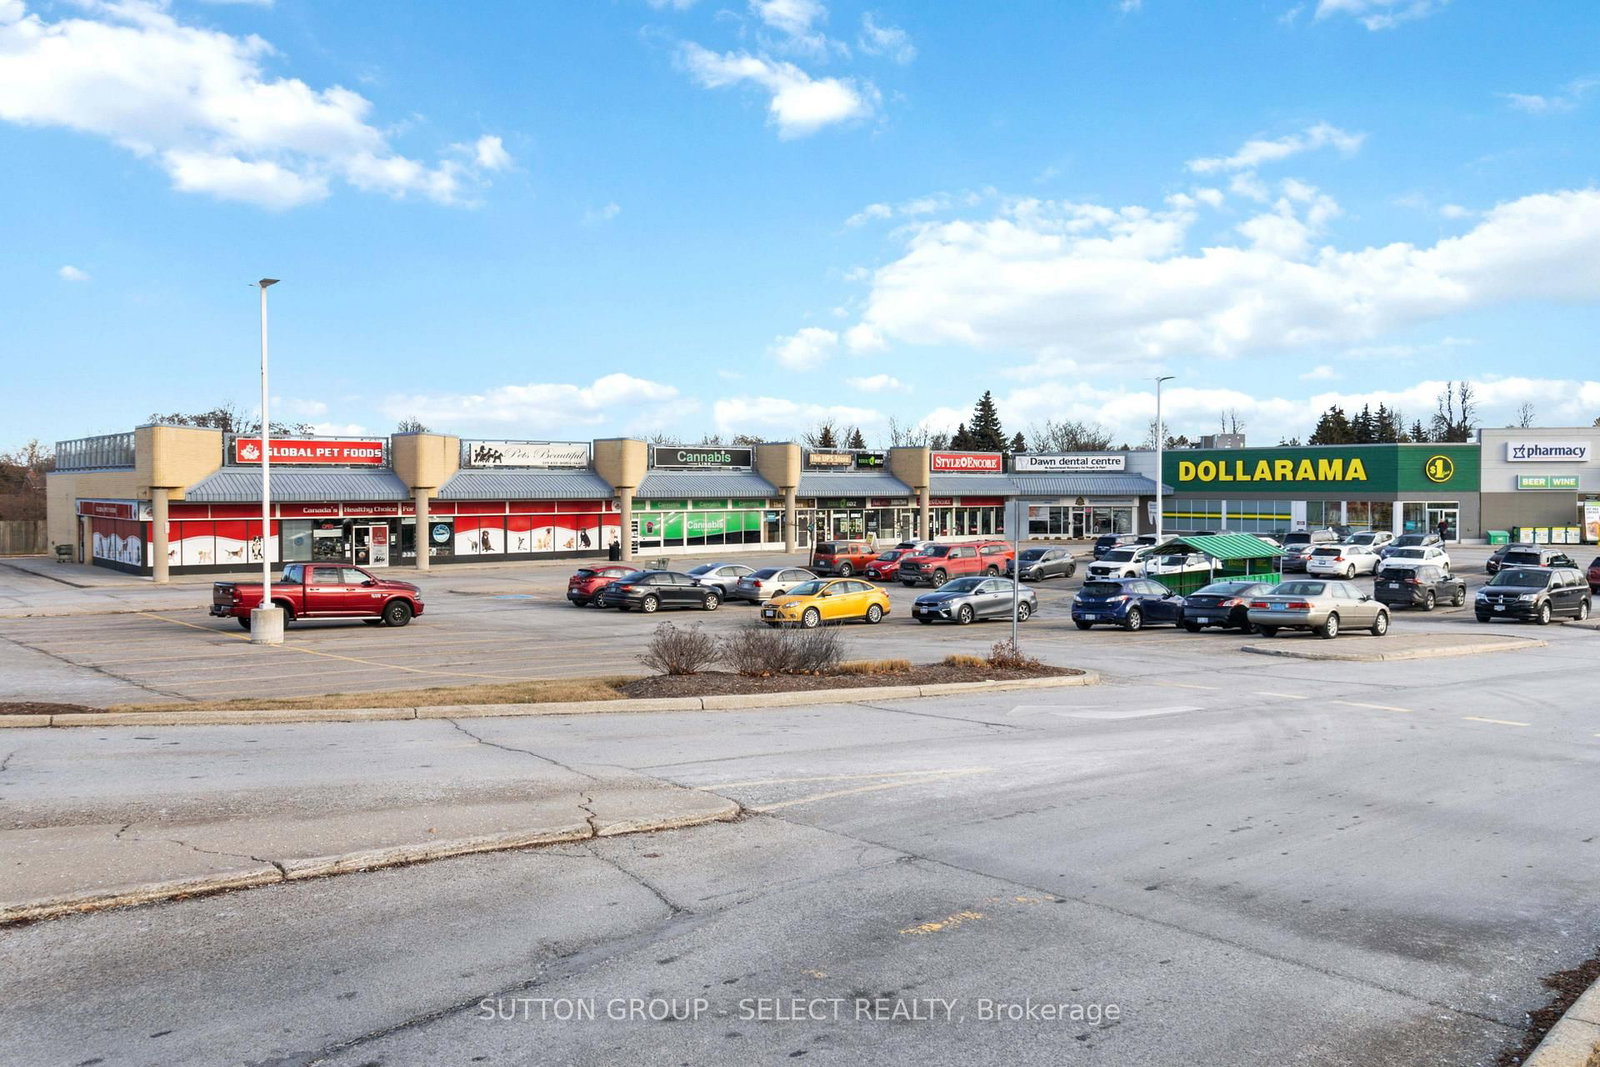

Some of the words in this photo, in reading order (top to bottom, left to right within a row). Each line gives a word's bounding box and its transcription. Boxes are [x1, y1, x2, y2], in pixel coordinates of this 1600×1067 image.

[268, 447, 314, 458] GLOBAL
[317, 448, 340, 459] PET
[344, 449, 382, 460] FOODS
[533, 449, 586, 460] Beautiful
[677, 450, 732, 463] Cannabis
[1527, 444, 1586, 459] pharmacy
[1030, 457, 1056, 466] Dawn
[1059, 457, 1088, 466] dental
[1091, 458, 1121, 466] centre
[1178, 458, 1367, 482] DOLLARAMA
[1522, 478, 1546, 486] BEER
[1552, 478, 1577, 486] WINE
[303, 506, 338, 514] Canada's
[344, 506, 373, 515] Healthy
[374, 505, 398, 513] Choice
[687, 520, 724, 530] Cannabis
